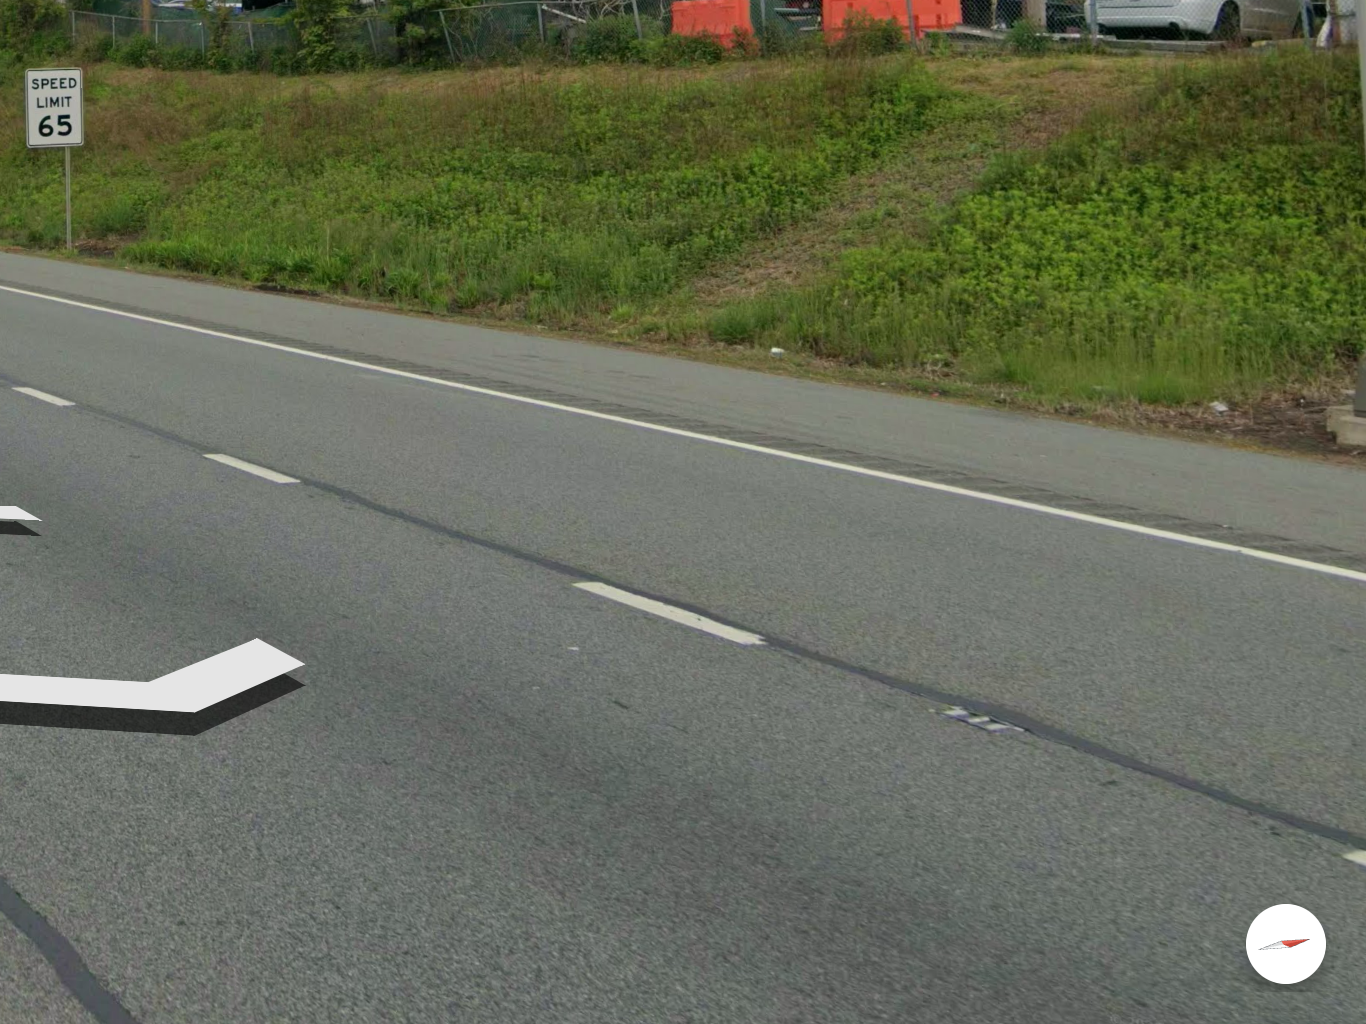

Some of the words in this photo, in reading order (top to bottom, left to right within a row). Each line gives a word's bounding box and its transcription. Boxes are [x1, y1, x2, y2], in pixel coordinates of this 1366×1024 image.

[31, 77, 77, 90] SPEED
[36, 96, 72, 108] LIMIT
[38, 114, 72, 137] 65
